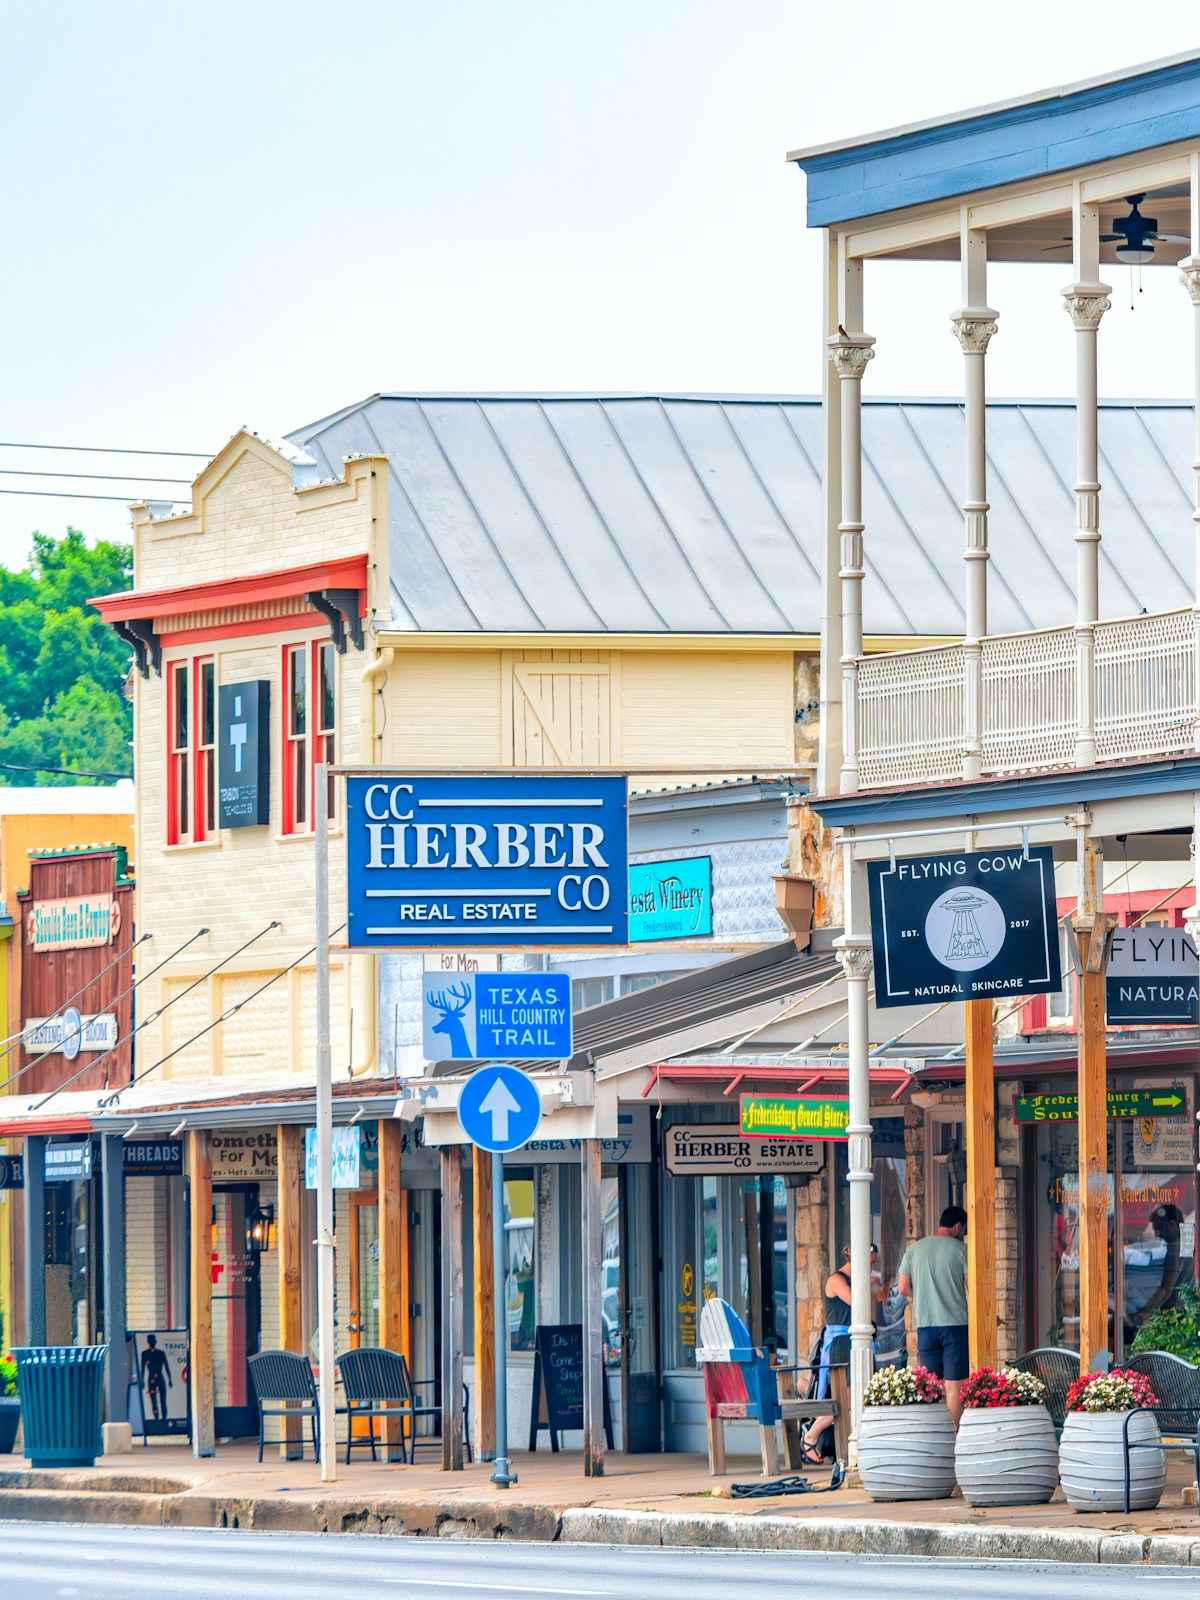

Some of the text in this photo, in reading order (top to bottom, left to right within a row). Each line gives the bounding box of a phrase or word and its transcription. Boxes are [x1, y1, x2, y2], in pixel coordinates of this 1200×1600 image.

[364, 784, 414, 820] CC
[365, 823, 609, 868] HERBER
[899, 855, 1023, 880] FLYING COW
[557, 874, 610, 910] CO
[400, 903, 537, 920] REAL ESTATE
[630, 877, 704, 931] esta Winery
[1010, 920, 1029, 928] 2017
[901, 930, 919, 938] EST.
[440, 953, 479, 972] For Men
[914, 979, 1023, 997] NATURAL SKINCARE
[1119, 986, 1199, 1001] NATURA
[488, 989, 557, 1005] TEXAS
[480, 1009, 565, 1025] HILL COUNTRY
[492, 1029, 556, 1046] TRAIL
[1031, 1092, 1139, 1108] Frederburg
[748, 1103, 843, 1130] Fredericksburg General Store
[1034, 1106, 1138, 1120] Souirs
[212, 1133, 278, 1148] ometh
[674, 1131, 690, 1141] CC
[123, 1146, 179, 1161] THREADS
[520, 1137, 632, 1160] iesta Wery
[674, 1142, 751, 1156] HERBER
[761, 1145, 813, 1157] ESTATE
[220, 1150, 278, 1167] For Me
[734, 1157, 751, 1167] CO
